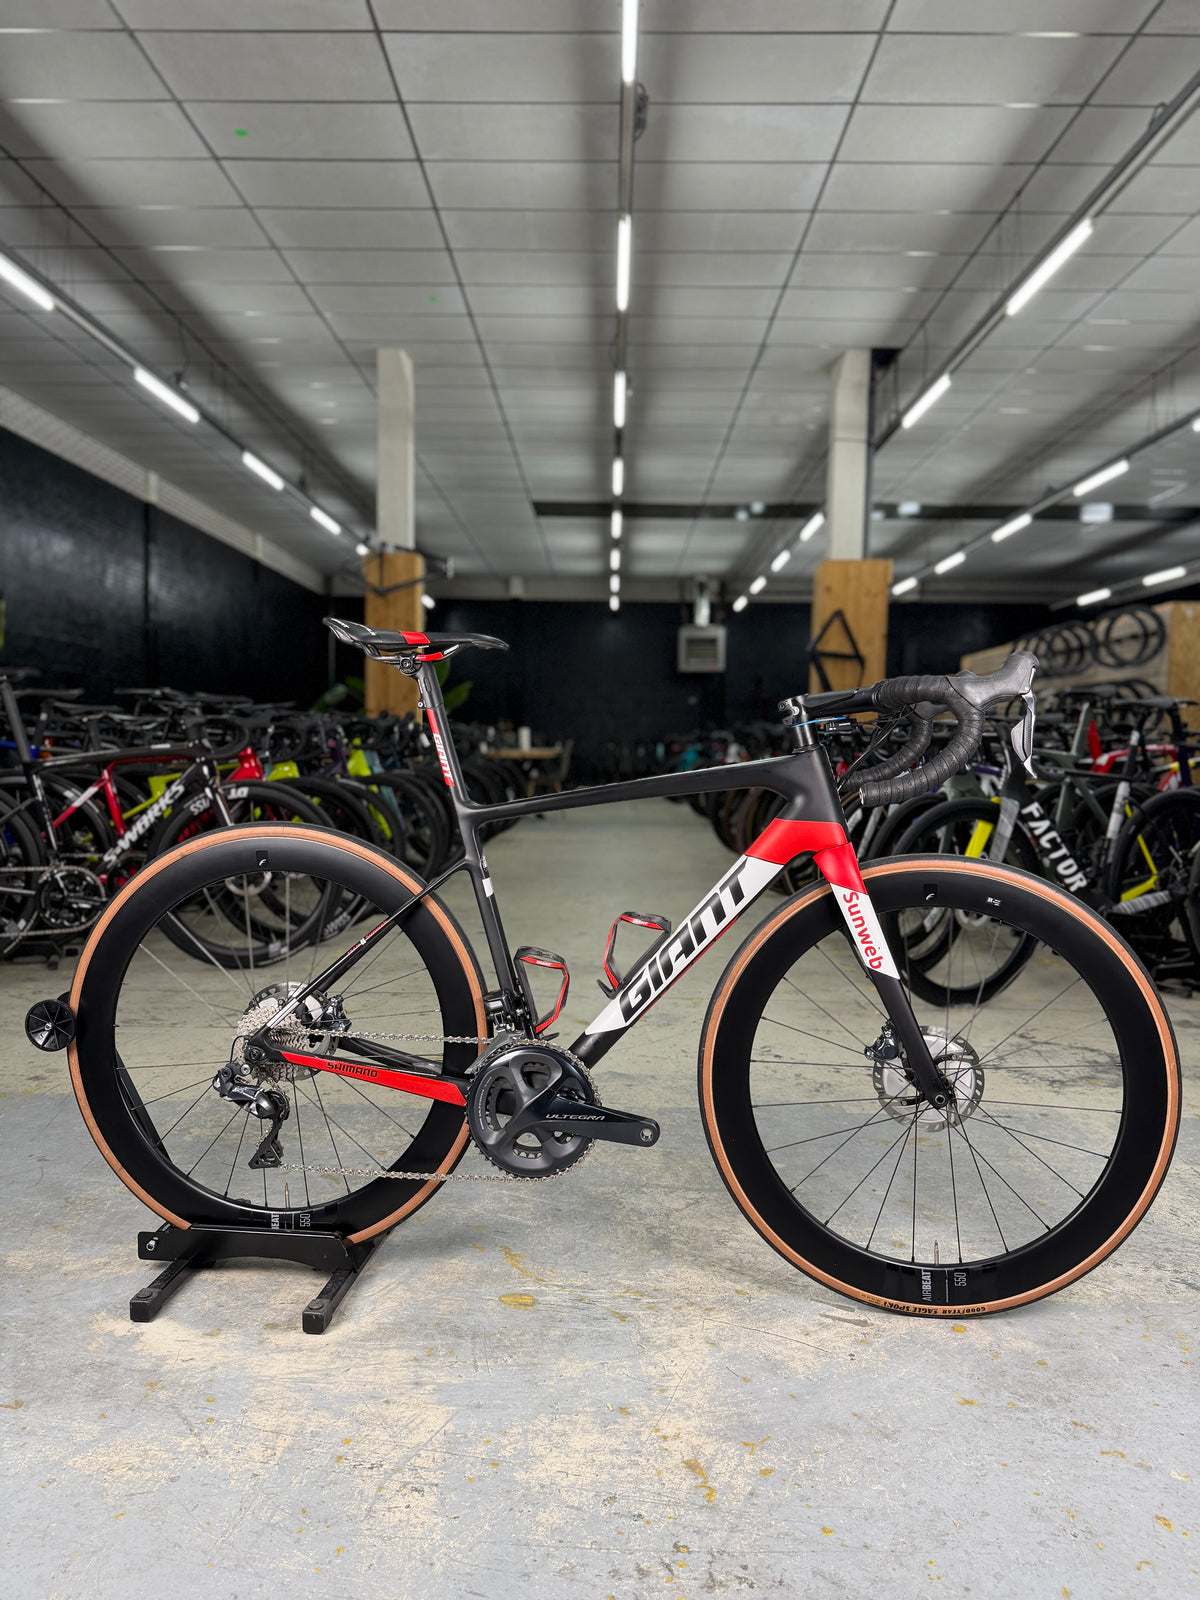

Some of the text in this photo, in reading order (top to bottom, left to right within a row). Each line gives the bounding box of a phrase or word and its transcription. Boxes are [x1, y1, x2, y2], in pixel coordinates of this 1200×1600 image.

[432, 733, 454, 782] GIANT
[103, 783, 185, 869] S-WORKS
[1021, 801, 1088, 893] FACTOR
[619, 857, 749, 1023] GIANT
[843, 891, 884, 970] Sunweb
[327, 1061, 378, 1078] SHIMANO
[545, 1113, 606, 1121] ULTEGRA
[300, 1213, 311, 1227] 550
[921, 1268, 932, 1302] AIRBEAT
[953, 1271, 967, 1287] 550
[912, 1307, 938, 1315] EAGLE
